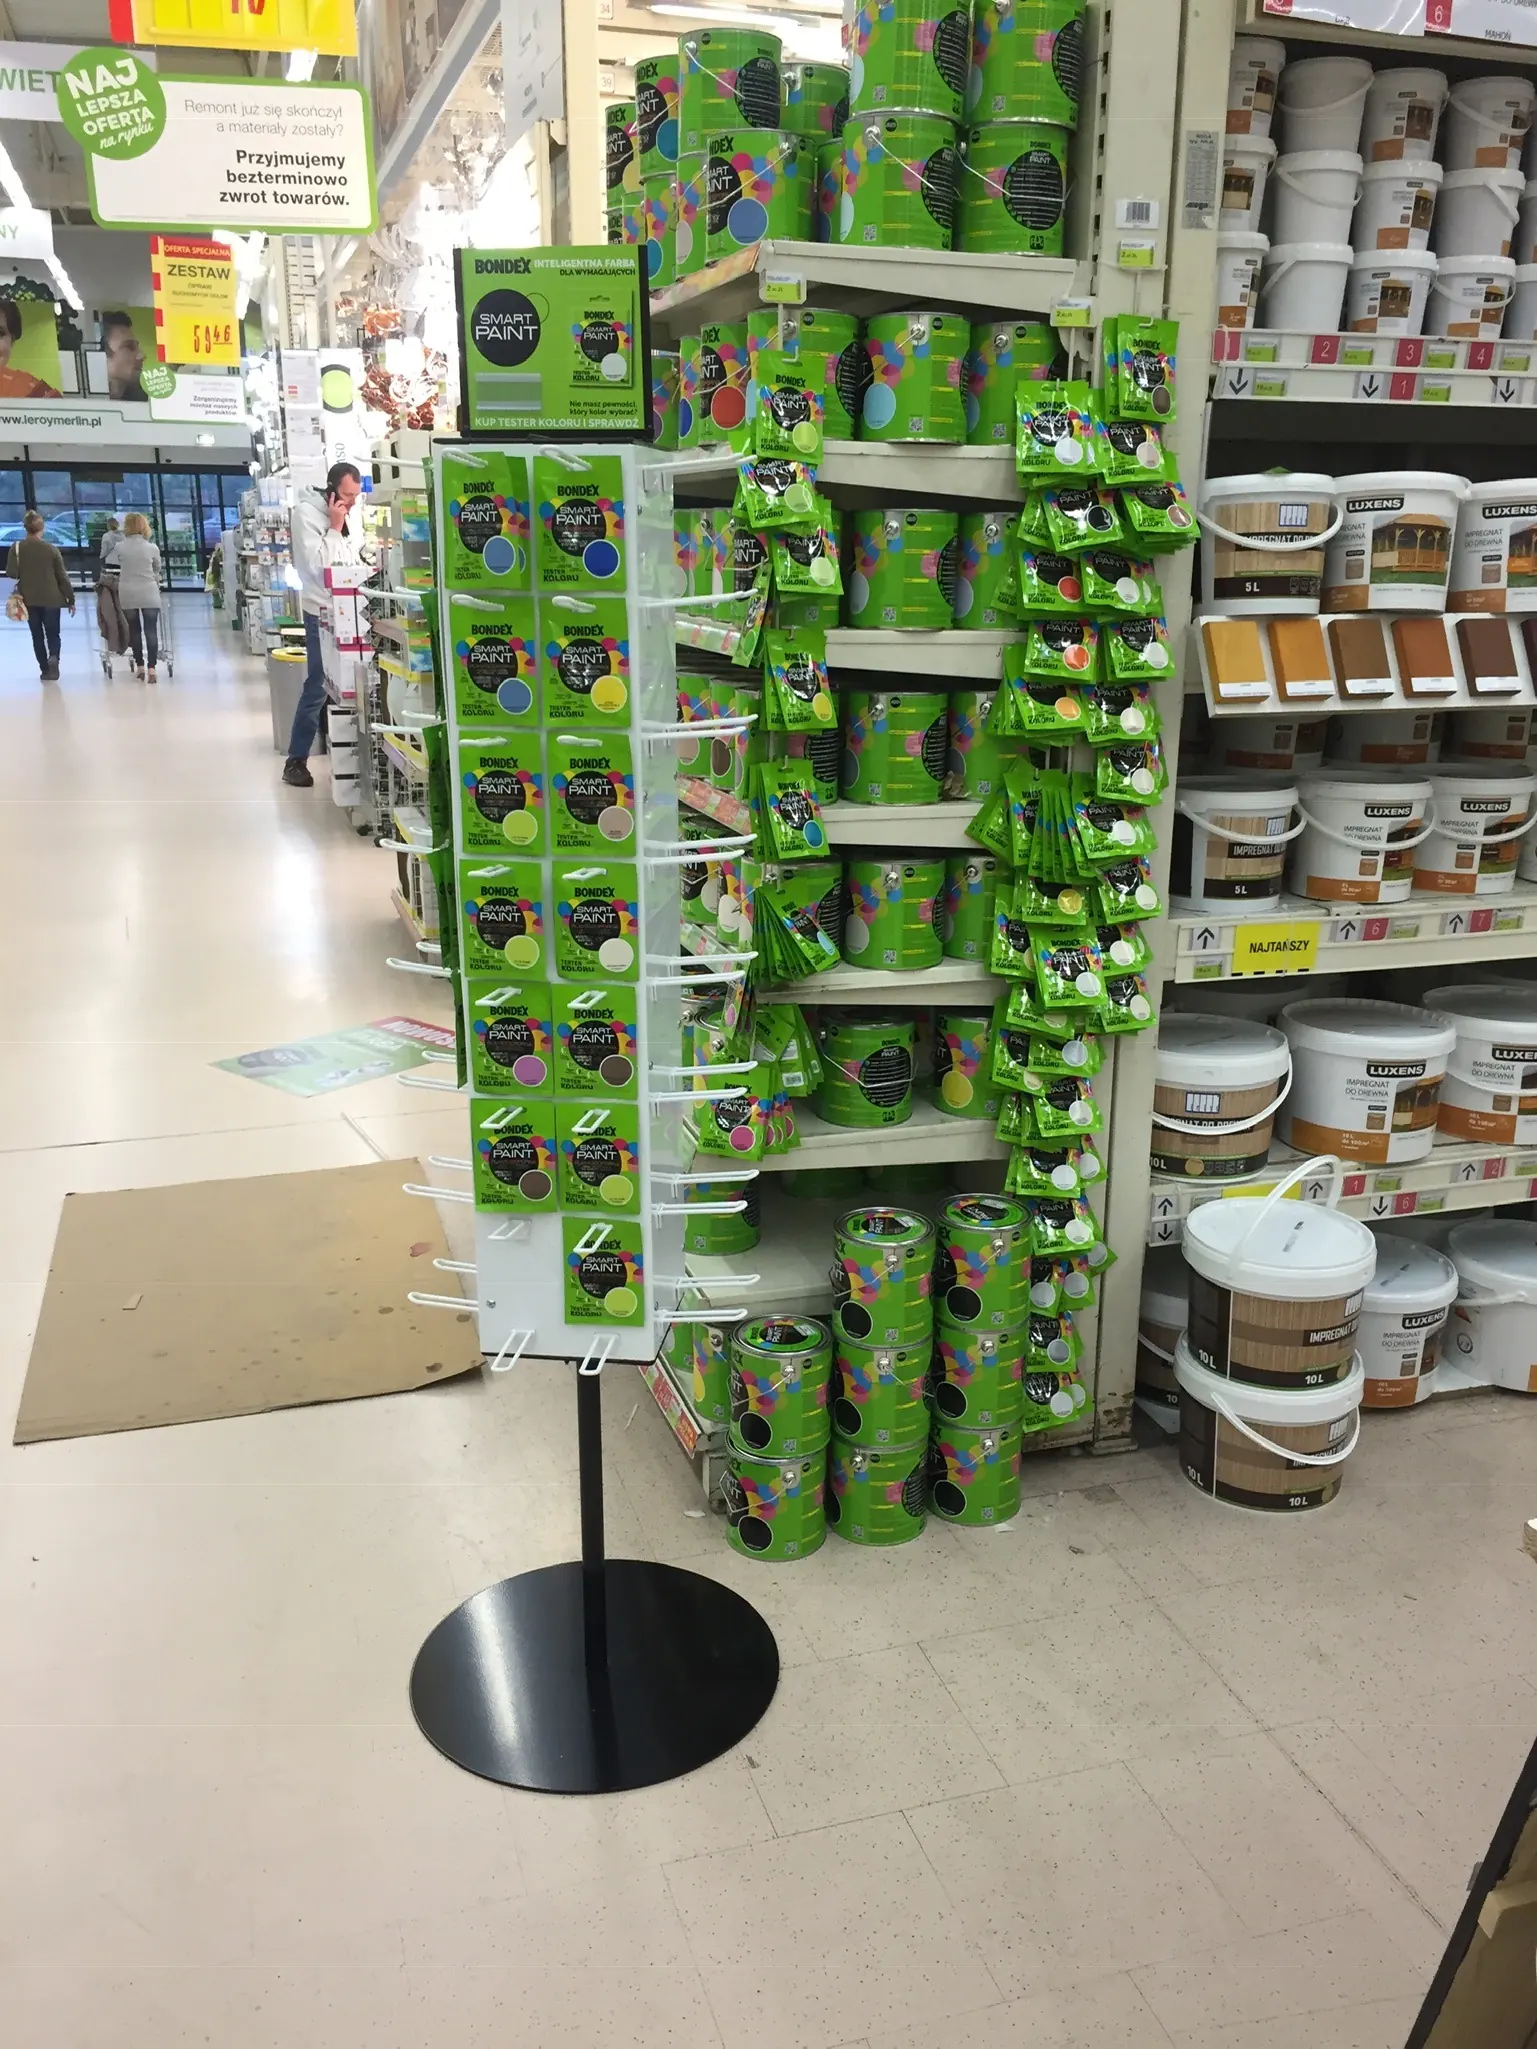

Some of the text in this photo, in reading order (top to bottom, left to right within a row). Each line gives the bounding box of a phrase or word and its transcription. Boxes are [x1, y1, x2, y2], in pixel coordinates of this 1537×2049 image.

[1434, 5, 1443, 23] 6
[65, 58, 138, 99] NAJ
[76, 89, 147, 117] LEPSZA
[184, 100, 342, 121] Remont już się skończył
[83, 106, 155, 135] OFERTA
[216, 121, 344, 138] a materiały zostały?
[100, 123, 154, 149] na rynku
[236, 149, 346, 170] Przyjmujemy
[227, 169, 348, 186] bezterminowo
[219, 190, 349, 206] zwrot towarów.
[165, 244, 230, 256] OFERTA SPECJALNA
[475, 256, 635, 274] BONDEX INTELIGENTNA FARBA
[167, 264, 230, 280] ZESTAW
[575, 268, 636, 277] WYMAGAJĄCYCH
[479, 313, 532, 325] SMART
[584, 310, 615, 321] BONDEX
[475, 326, 538, 340] PAINT
[583, 332, 615, 340] PAINT
[1321, 341, 1331, 357] 2
[1406, 344, 1414, 360] 3
[1477, 348, 1485, 364] 4
[143, 366, 167, 379] NAJ
[775, 374, 806, 388] BONDEX
[1401, 380, 1407, 394] 1
[570, 408, 587, 416] który
[609, 408, 638, 416] wybrać?
[475, 418, 496, 427] KUP
[499, 418, 536, 427] TESTER
[538, 418, 580, 427] KOLORU
[588, 417, 639, 428] SPRAWDŹ
[463, 480, 495, 494] BONDEX
[557, 484, 600, 496] BONDEX
[464, 503, 495, 511] SMART
[559, 506, 598, 514] SMART
[1349, 499, 1401, 511] LUXENS
[461, 511, 498, 522] PAINT
[1485, 505, 1537, 517] LUXENS
[556, 514, 601, 525] PAINT
[1245, 582, 1260, 592] 5 L
[471, 624, 513, 635] BONDEX
[563, 624, 605, 636] BONDEX
[1046, 624, 1081, 633] PAINT
[473, 645, 511, 653] SMART
[565, 646, 603, 654] SMART
[471, 653, 513, 664] PAINT
[562, 653, 606, 664] PAINT
[480, 757, 519, 768] BONDEX
[570, 757, 611, 769] BONDEX
[482, 777, 517, 785] SMART
[478, 784, 521, 795] PAINT
[568, 785, 612, 796] PAINT
[1367, 806, 1410, 816] LUXENS
[1463, 801, 1509, 811] LUXENS
[1440, 820, 1479, 828] IMPREGNAT
[1233, 845, 1273, 856] IMPREGNAT
[481, 886, 519, 897] BONDEX
[574, 886, 615, 898] BONDEX
[1235, 885, 1247, 894] 5 L
[480, 912, 521, 922] PAINT
[573, 913, 616, 923] PAINT
[1479, 913, 1485, 926] 7
[1372, 923, 1380, 935] 6
[1249, 938, 1310, 953] NAJTAŃSZY
[490, 1005, 528, 1016] BONDEX
[574, 1008, 614, 1019] BONDEX
[489, 1031, 530, 1041] PAINT
[573, 1034, 615, 1044] PAINT
[1369, 1065, 1424, 1076] LUXENS
[1472, 1061, 1516, 1071] IMPREGNAT
[1484, 1071, 1515, 1080] DREWNA
[1346, 1079, 1390, 1088] IMPREGNAT
[1357, 1088, 1389, 1097] DREWNA
[496, 1142, 531, 1150] SMART
[492, 1149, 534, 1159] PAINT
[576, 1150, 617, 1160] PAINT
[1160, 1159, 1167, 1169] L
[1492, 1163, 1498, 1174] 2
[1352, 1180, 1358, 1191] 1
[1402, 1197, 1409, 1209] 6
[582, 1263, 623, 1273] PAINT
[1405, 1311, 1444, 1327] LUXENS
[1310, 1325, 1352, 1343] IMPREGNAT
[1198, 1349, 1217, 1370] 10 L
[1305, 1374, 1324, 1385] 10 L
[1166, 1395, 1178, 1403] 10
[1187, 1465, 1203, 1486] 10 L
[1289, 1496, 1308, 1506] 10 L
